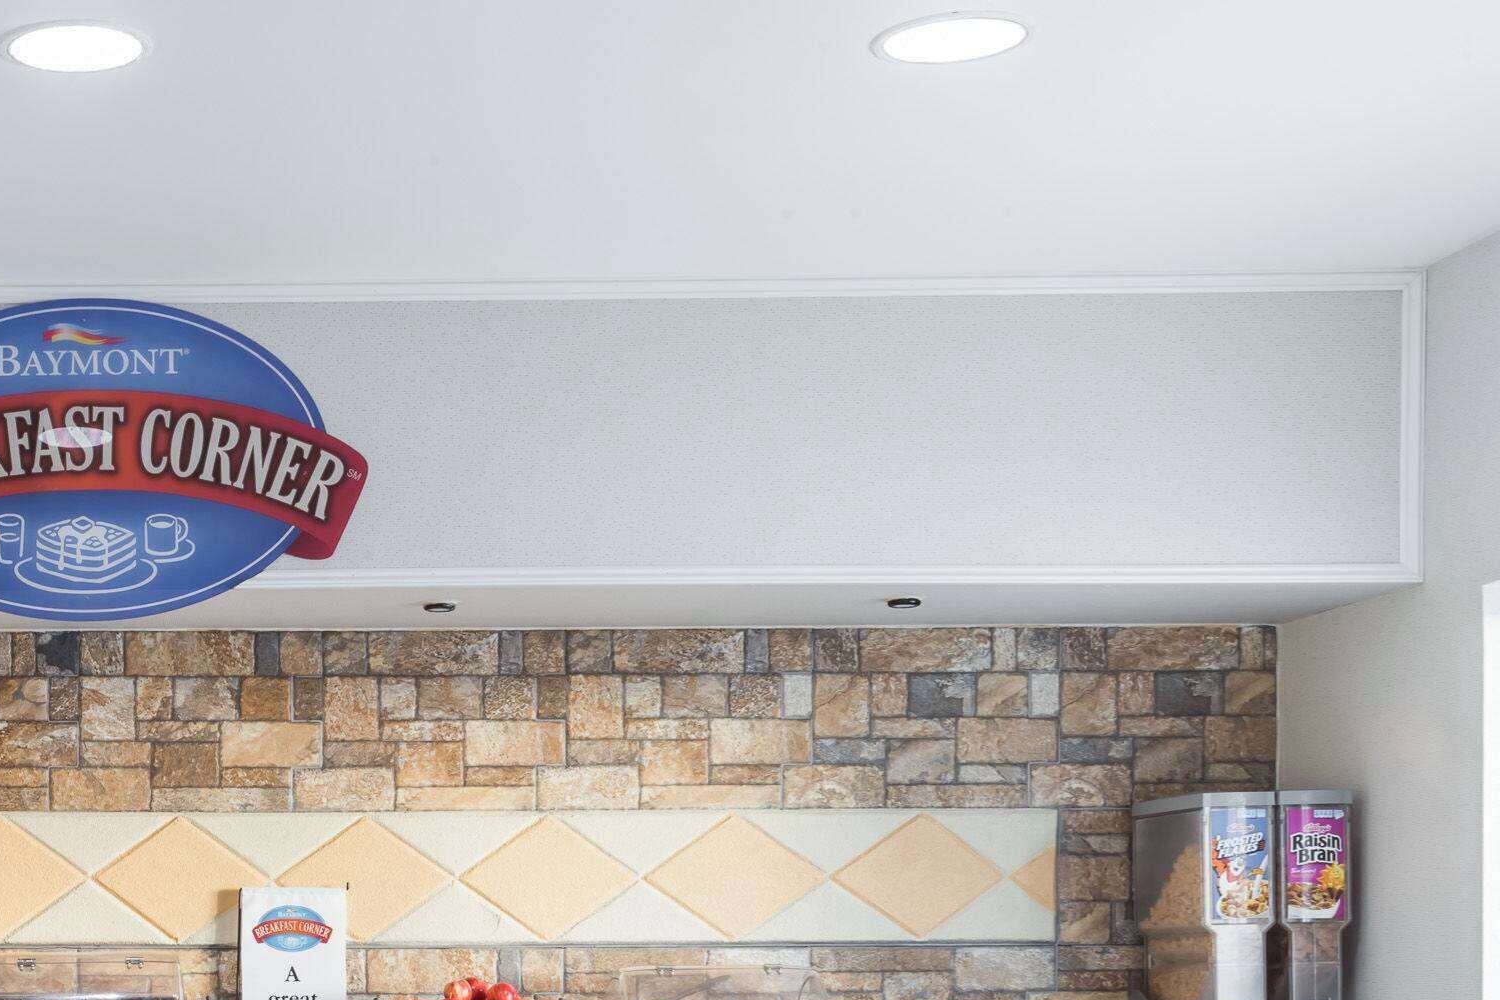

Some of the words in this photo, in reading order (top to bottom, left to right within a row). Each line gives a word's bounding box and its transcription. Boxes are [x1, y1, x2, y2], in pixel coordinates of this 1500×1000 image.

[141, 406, 345, 521] CORNER
[1216, 832, 1263, 851] FROSTED
[1291, 833, 1341, 851] Raisin
[1298, 848, 1337, 863] Bran
[254, 920, 297, 938] BREAKFAST
[299, 920, 332, 938] CORNER
[284, 966, 301, 982] A
